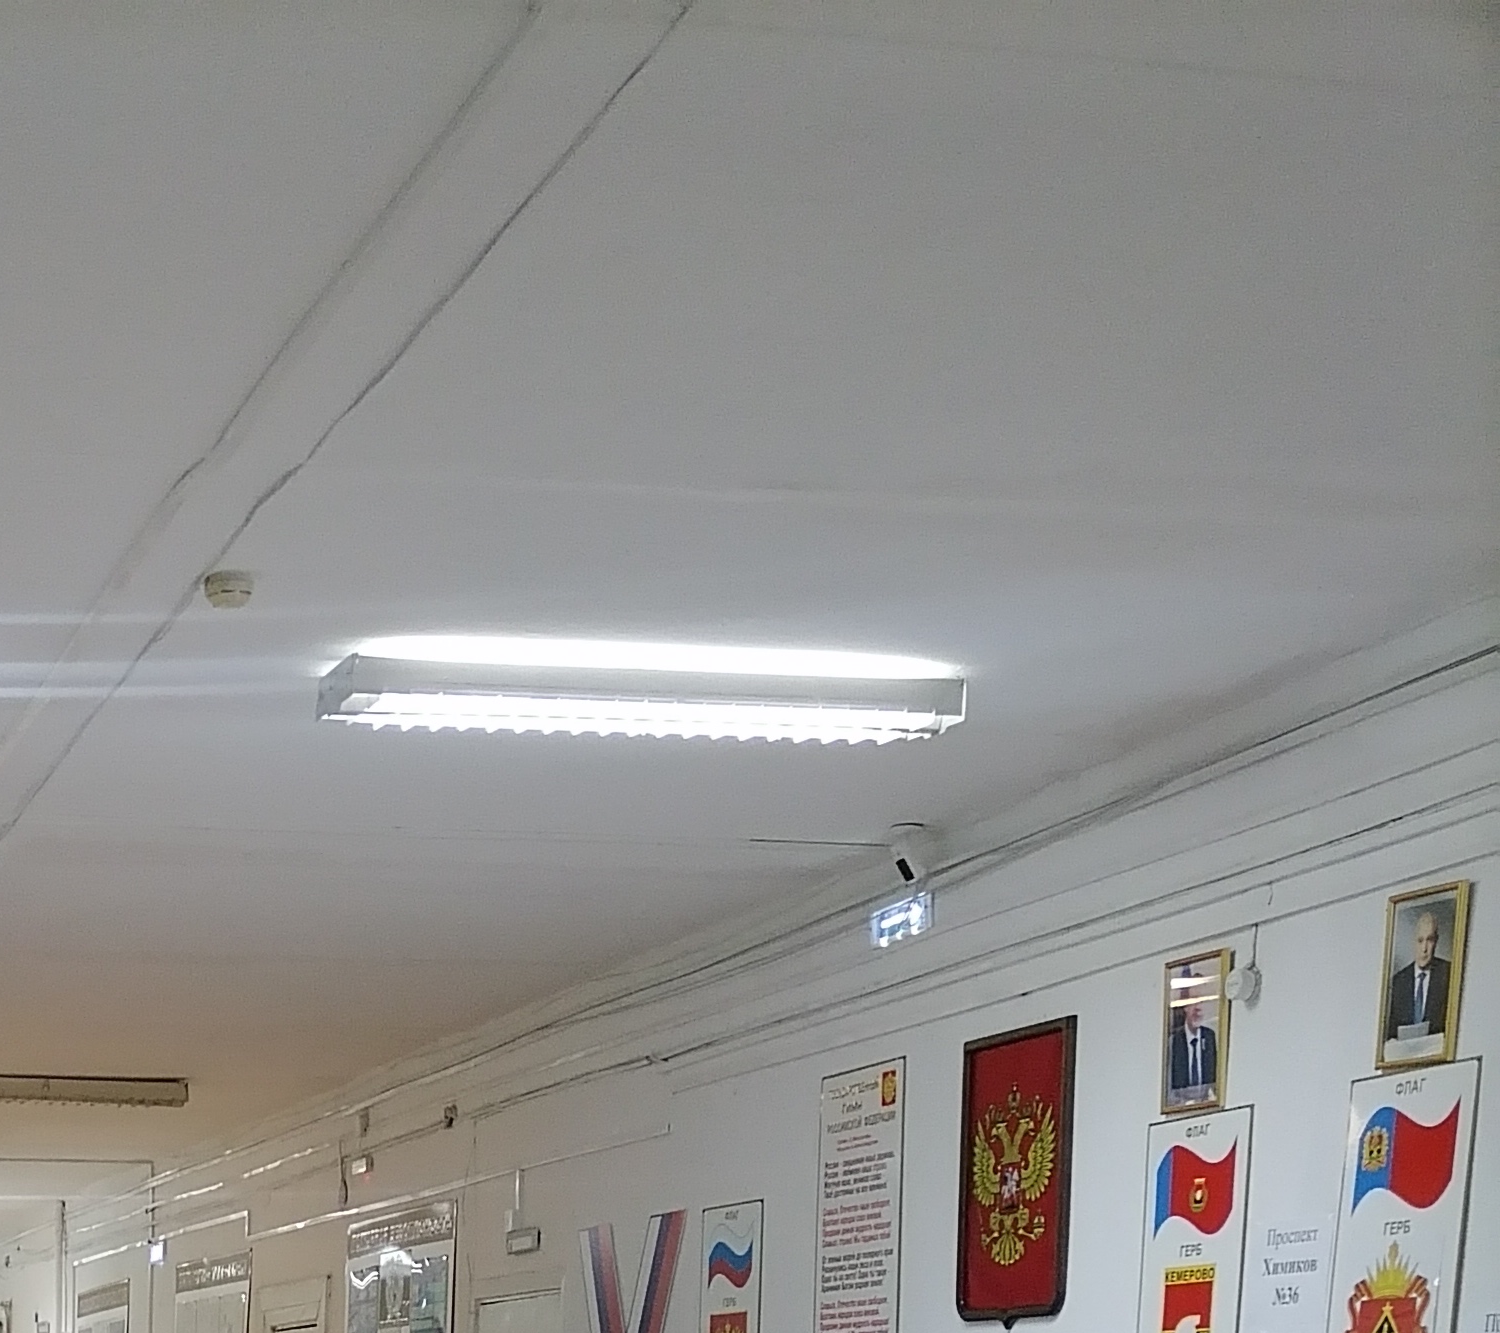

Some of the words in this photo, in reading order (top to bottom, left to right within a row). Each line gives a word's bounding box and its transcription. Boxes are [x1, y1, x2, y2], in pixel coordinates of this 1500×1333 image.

[1395, 1077, 1427, 1095] ФЛАГ
[1185, 1122, 1211, 1139] ФЛАГ
[1383, 1219, 1411, 1237] ГЕРБ
[1266, 1228, 1318, 1251] Проспект
[1179, 1243, 1202, 1258] ГЕРБ
[1164, 1266, 1215, 1283] КЕМЕРОВО
[1262, 1257, 1318, 1277] Химиков
[1271, 1287, 1299, 1307] №36
